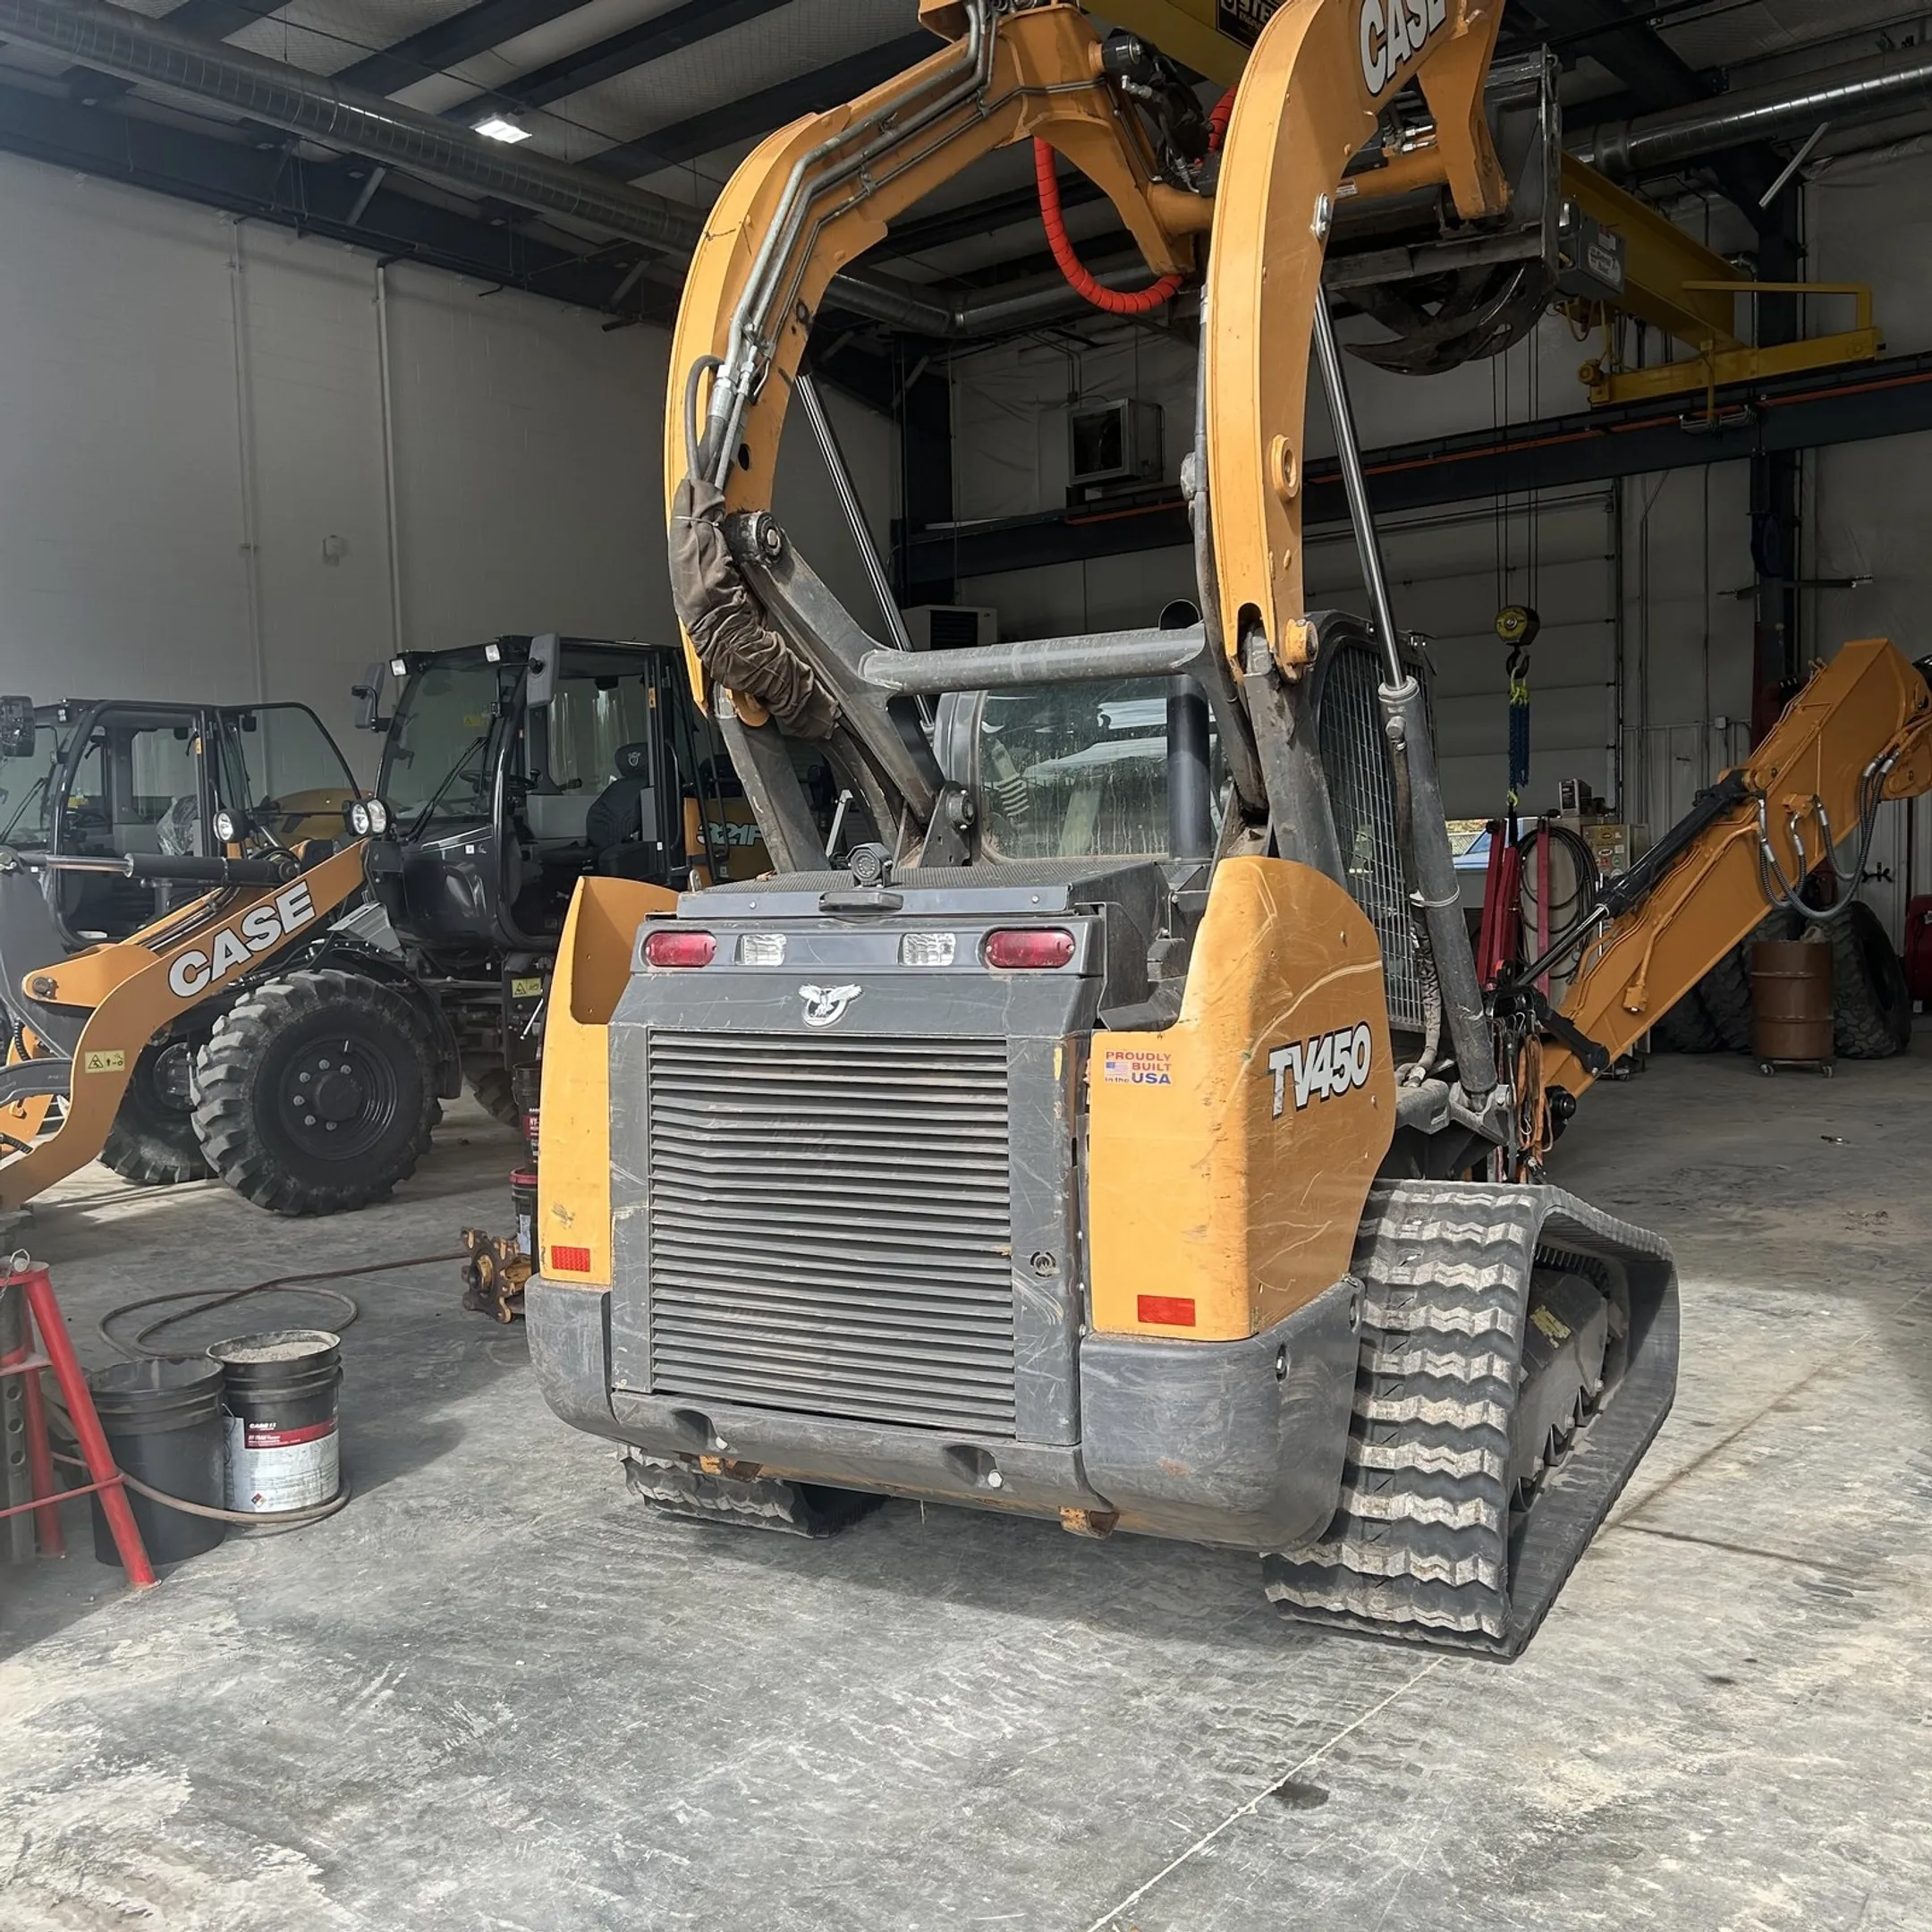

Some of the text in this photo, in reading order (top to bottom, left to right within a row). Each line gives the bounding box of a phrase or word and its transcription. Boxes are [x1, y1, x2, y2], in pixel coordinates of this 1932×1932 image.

[168, 879, 316, 998] CASE
[1106, 1051, 1172, 1061] PROUDLY
[1131, 1062, 1172, 1072] BUILT
[1268, 1021, 1372, 1120] TV450
[1131, 1072, 1171, 1084] USA
